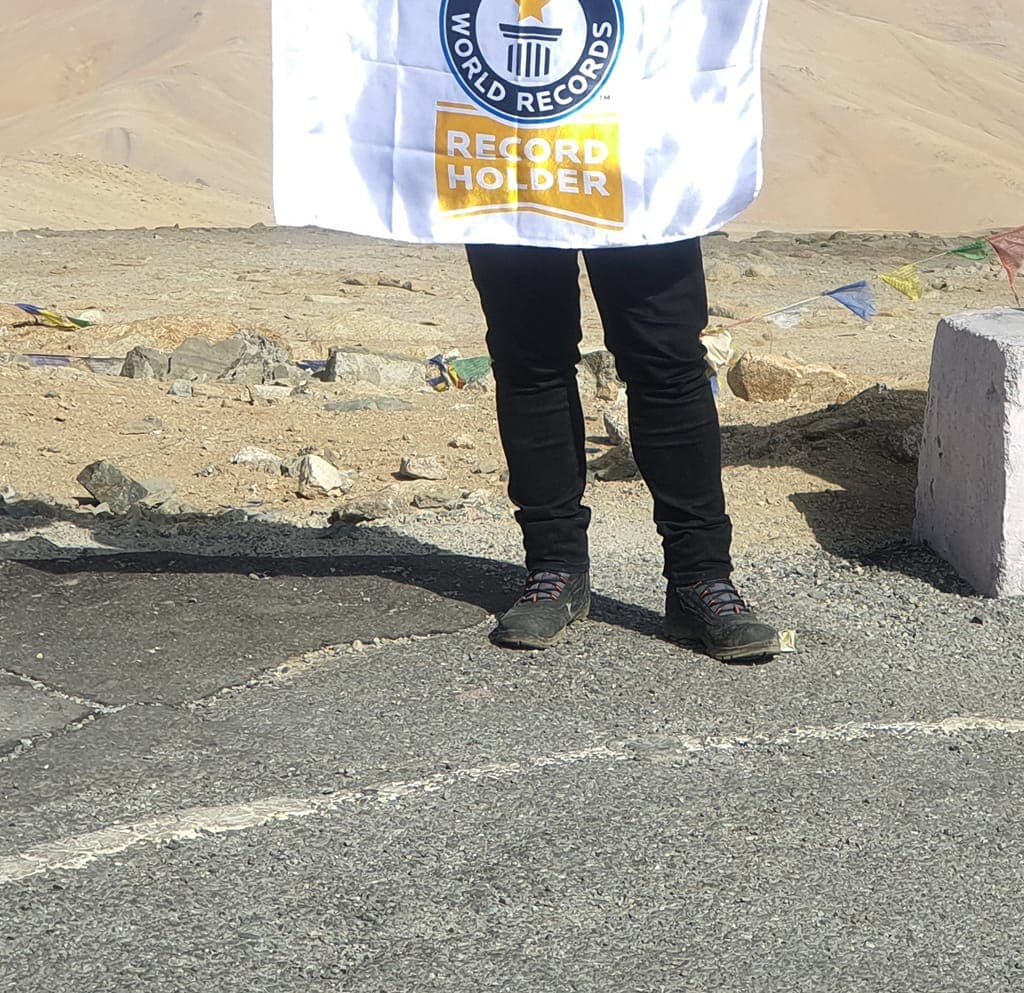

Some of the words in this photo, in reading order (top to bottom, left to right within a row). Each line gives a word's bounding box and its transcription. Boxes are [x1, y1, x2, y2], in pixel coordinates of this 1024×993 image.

[451, 12, 506, 102] WORLD
[517, 21, 613, 113] RECORDS
[447, 130, 609, 165] RECORD
[448, 164, 611, 197] HOLDER
